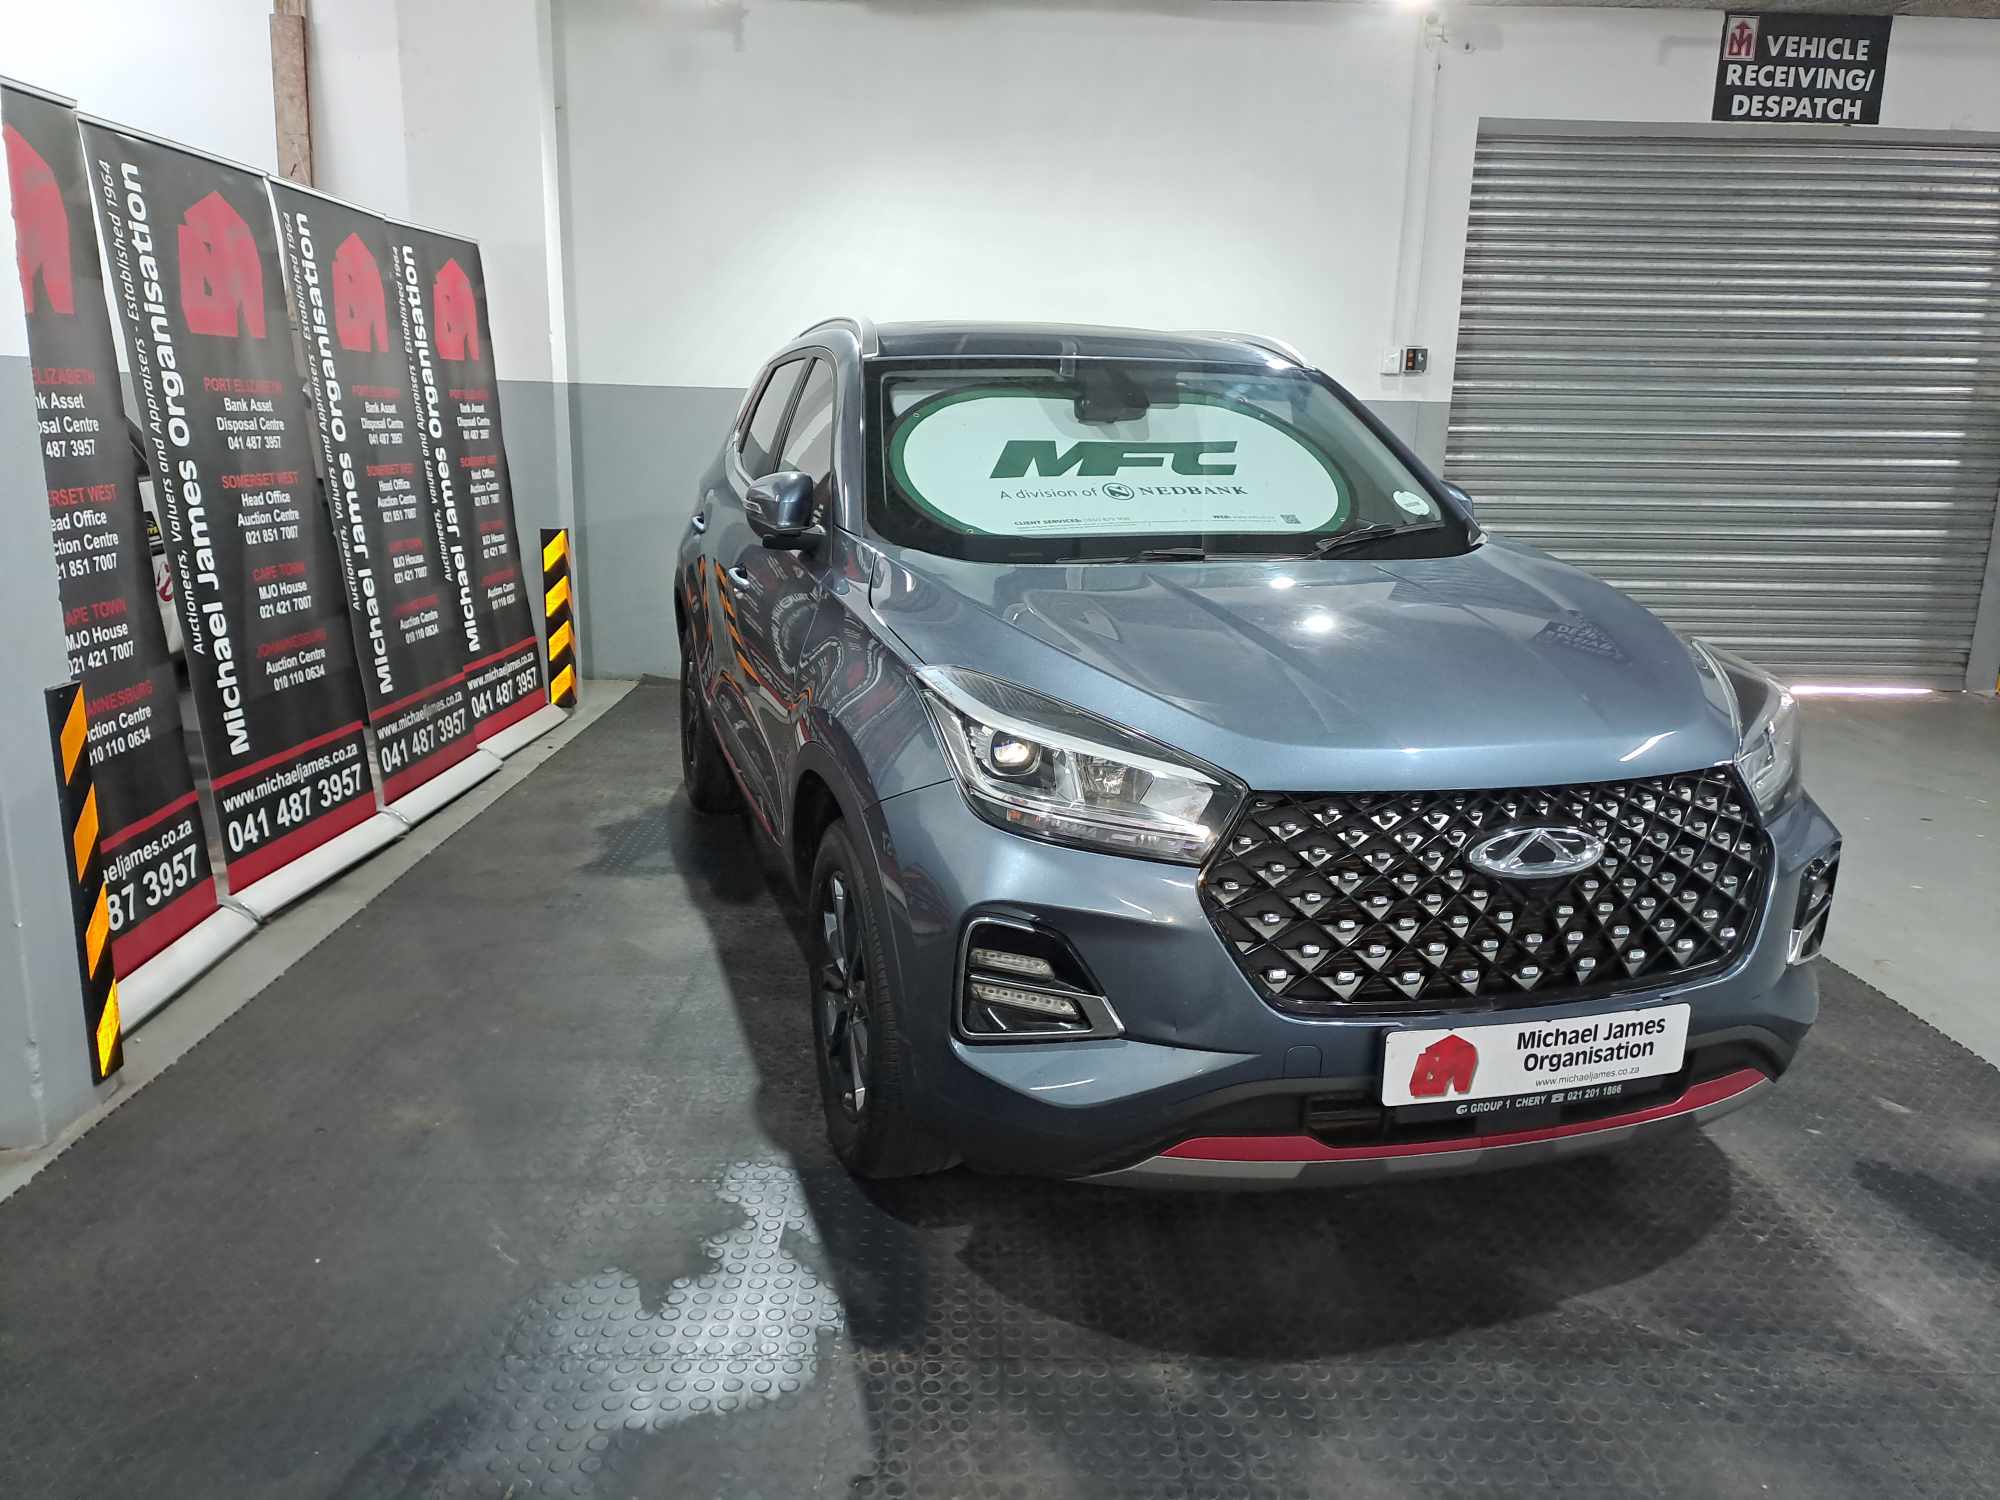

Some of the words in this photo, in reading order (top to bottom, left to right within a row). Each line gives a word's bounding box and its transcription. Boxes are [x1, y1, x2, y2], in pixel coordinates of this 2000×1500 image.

[1767, 35, 1870, 61] VEHICLE
[1726, 64, 1875, 91] RECEIVING/
[1731, 95, 1862, 120] DESPATCH
[98, 159, 118, 208] 1964
[107, 211, 140, 322] Established
[121, 162, 190, 447] Organisation
[296, 213, 346, 442] Organisation
[402, 246, 442, 438] Organisation
[134, 337, 162, 434] Appraisers
[51, 393, 85, 409] Asset
[223, 397, 248, 412] Bank
[250, 399, 273, 412] Asset
[63, 416, 99, 433] Centre
[216, 416, 257, 433] Disposal
[259, 417, 285, 431] Centre
[46, 441, 66, 458] 487
[71, 439, 95, 457] 3957
[151, 437, 169, 473] and
[227, 437, 244, 450] 041
[245, 436, 262, 449] 487
[264, 435, 282, 448] 3957
[321, 434, 333, 462] and
[990, 440, 1237, 479] MFC
[88, 484, 117, 502] WEST
[241, 493, 264, 507] Head
[265, 490, 291, 504] Office
[328, 467, 344, 519] Valuers
[339, 452, 368, 559] James
[435, 447, 460, 538] James
[1000, 489, 1012, 500] A
[1015, 487, 1077, 499] division
[1080, 487, 1097, 498] of
[1140, 484, 1248, 496] NEDBANK
[73, 510, 107, 528] Office
[162, 478, 183, 543] Valuers
[237, 513, 271, 527] Auction
[273, 509, 299, 522] Centre
[178, 460, 219, 590] James
[245, 531, 261, 545] 021
[262, 529, 279, 543] 851
[83, 532, 119, 552] Centre
[69, 557, 90, 577] 851
[92, 552, 118, 573] 7007
[177, 550, 206, 656] Auctioneers,
[258, 584, 278, 600] MJO
[279, 580, 307, 596] House
[450, 546, 481, 652] Michael
[260, 606, 275, 619] 021
[276, 600, 291, 615] 421
[65, 631, 90, 651] MJO
[92, 623, 129, 643] House
[357, 568, 394, 694] Michael
[87, 649, 108, 669] 421
[110, 641, 134, 662] 7007
[265, 656, 298, 675] Auction
[299, 648, 326, 665] Centre
[202, 602, 250, 756] Michael
[471, 690, 494, 718] 041
[496, 680, 513, 704] 487
[516, 667, 538, 695] 3957
[119, 705, 152, 730] Centre
[105, 737, 126, 758] 110
[128, 726, 152, 749] 0634
[381, 739, 408, 772] 041
[412, 724, 434, 757] 487
[438, 708, 465, 742] 3957
[223, 742, 358, 812] www.michaeljames.co.za
[228, 808, 270, 853] 041
[276, 786, 311, 827] 487
[318, 763, 361, 807] 3957
[142, 843, 197, 906] 3957
[1517, 1026, 1598, 1050] Michael
[1603, 1017, 1666, 1043] James
[1524, 1039, 1655, 1075] Organisation
[1535, 1066, 1640, 1088] www.michaeljames.co.za
[1470, 1101, 1503, 1114] GROUP
[1506, 1099, 1510, 1109] 1
[1515, 1095, 1547, 1108] CHERY
[1567, 1090, 1583, 1101] 021
[1584, 1087, 1600, 1099] 201
